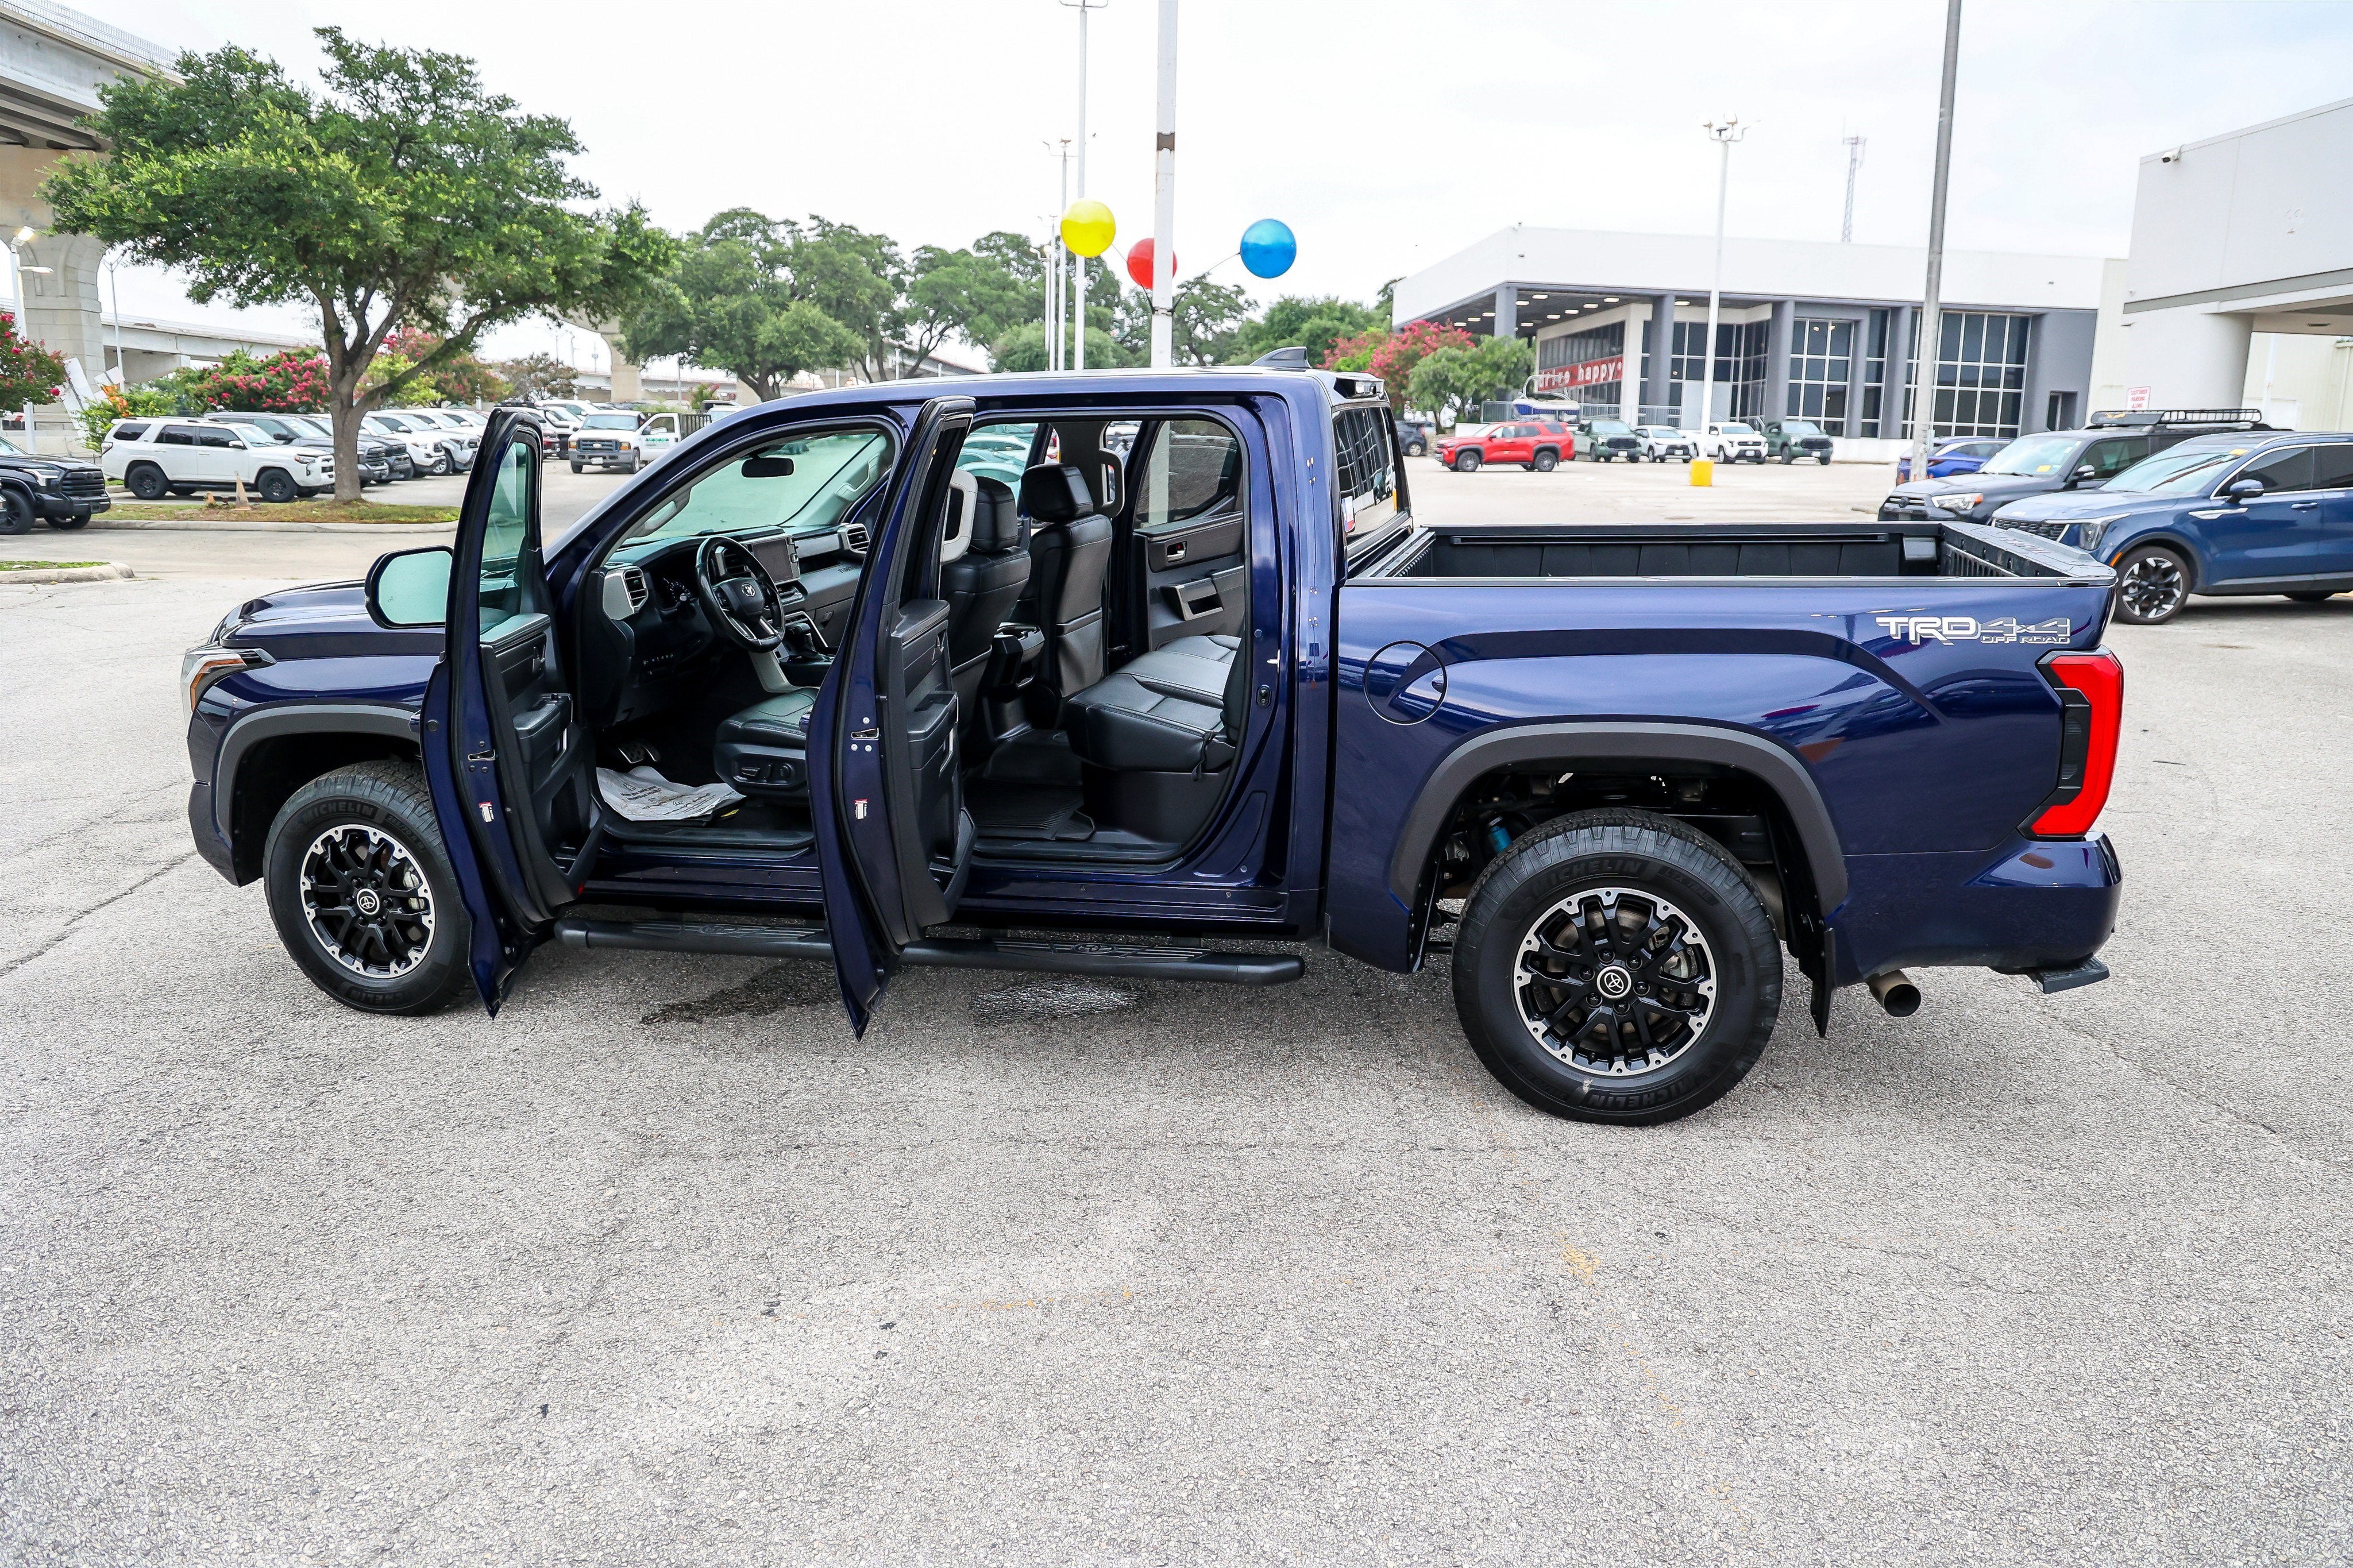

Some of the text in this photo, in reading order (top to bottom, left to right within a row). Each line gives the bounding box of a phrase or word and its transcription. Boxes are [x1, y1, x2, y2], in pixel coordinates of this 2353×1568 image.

[1876, 616, 1981, 645] TRD
[1981, 636, 2070, 644] OFF ROAD
[302, 802, 373, 822] MICHELIN
[1532, 860, 1637, 896] MICHELIN
[1588, 1076, 1695, 1108] MICHELIN
